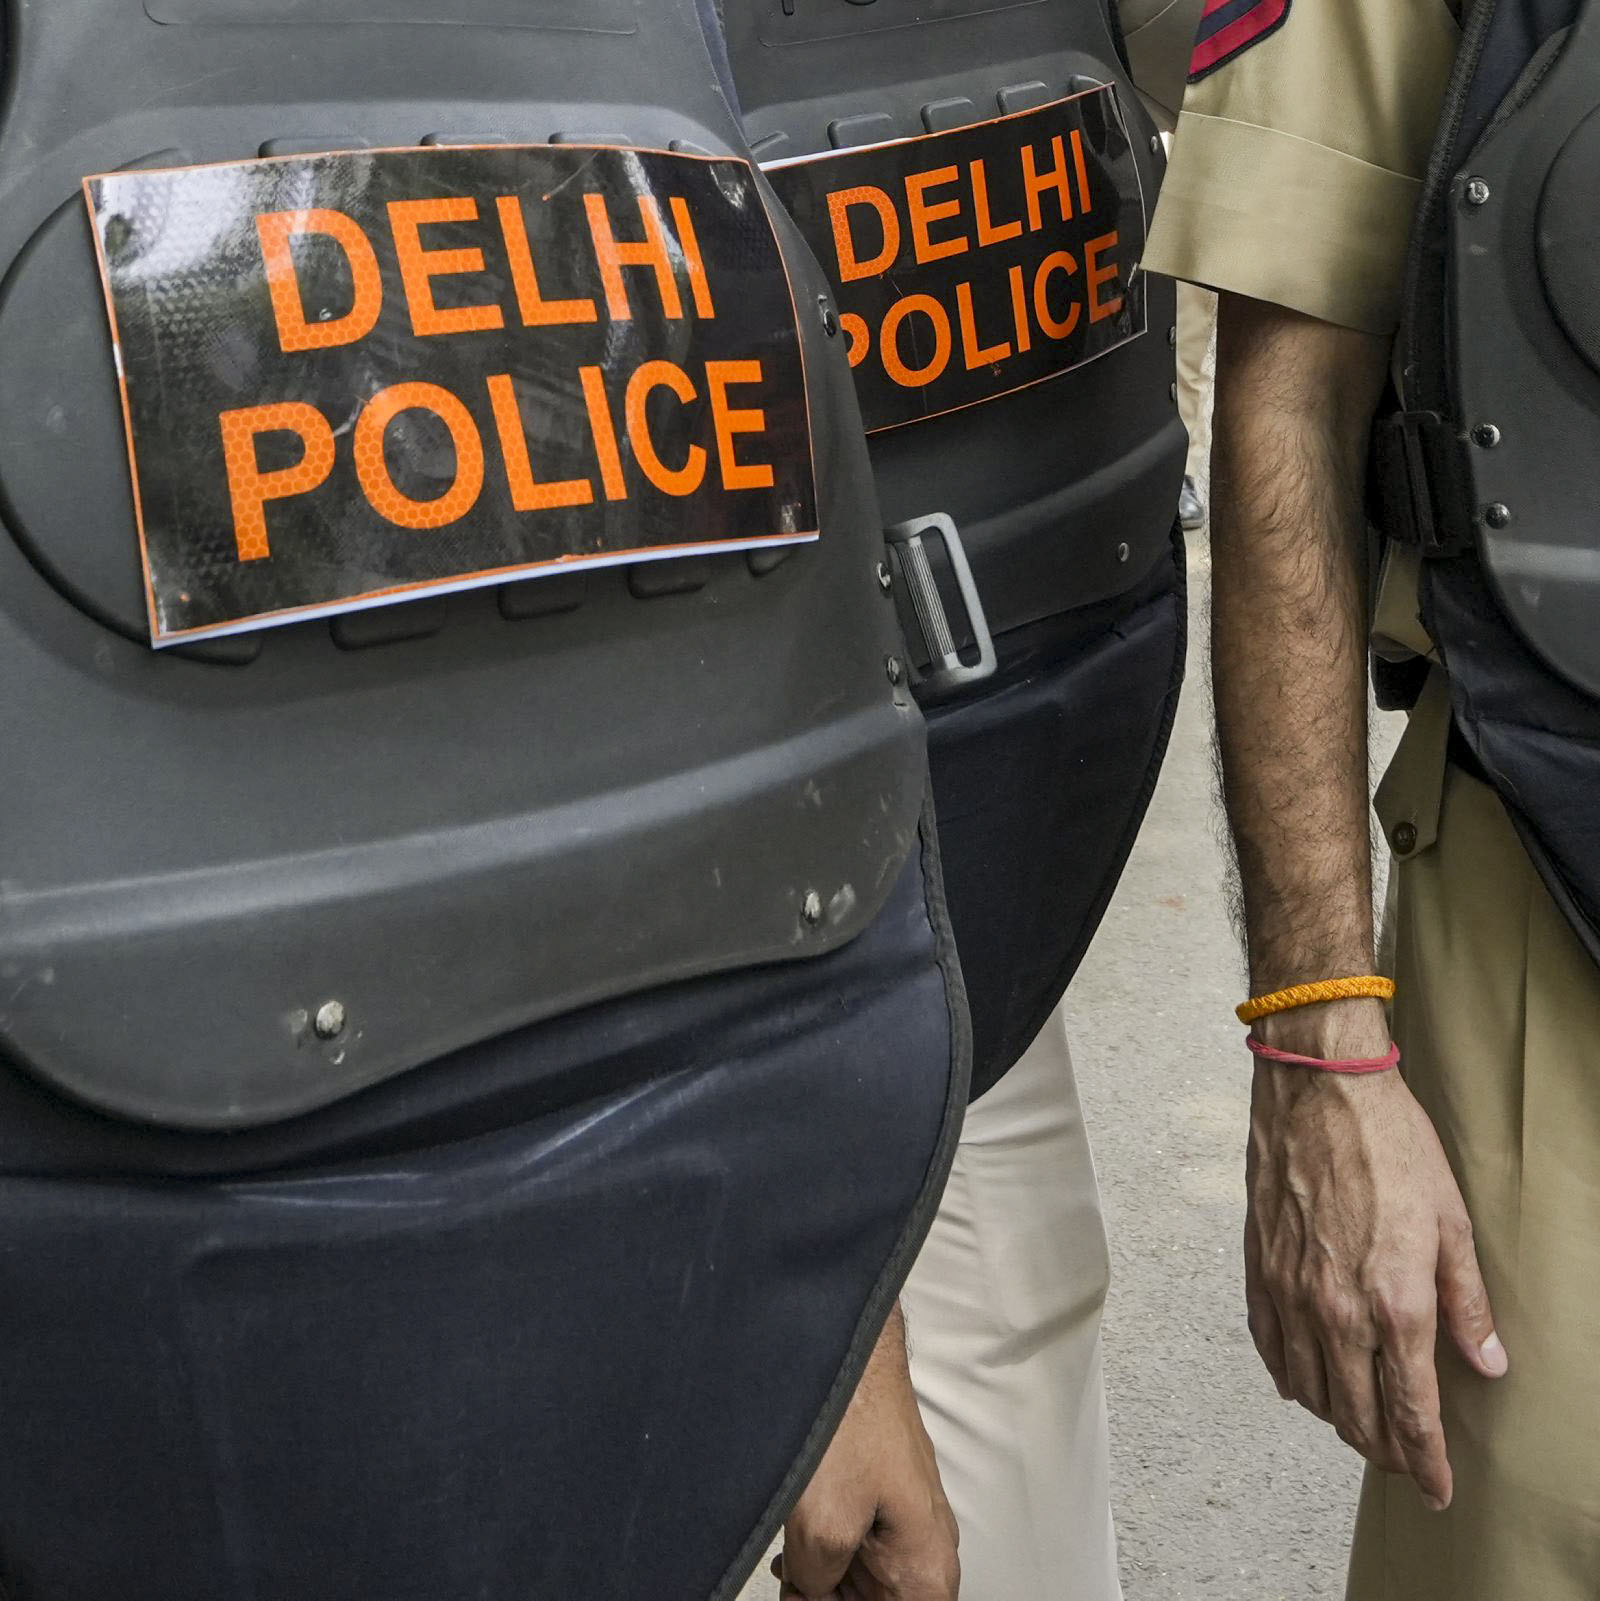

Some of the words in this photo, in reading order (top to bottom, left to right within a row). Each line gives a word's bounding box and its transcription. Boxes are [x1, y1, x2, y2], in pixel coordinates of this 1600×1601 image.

[254, 192, 716, 353] DELHI
[826, 129, 1092, 282] DELHI
[218, 359, 775, 561] POLICE
